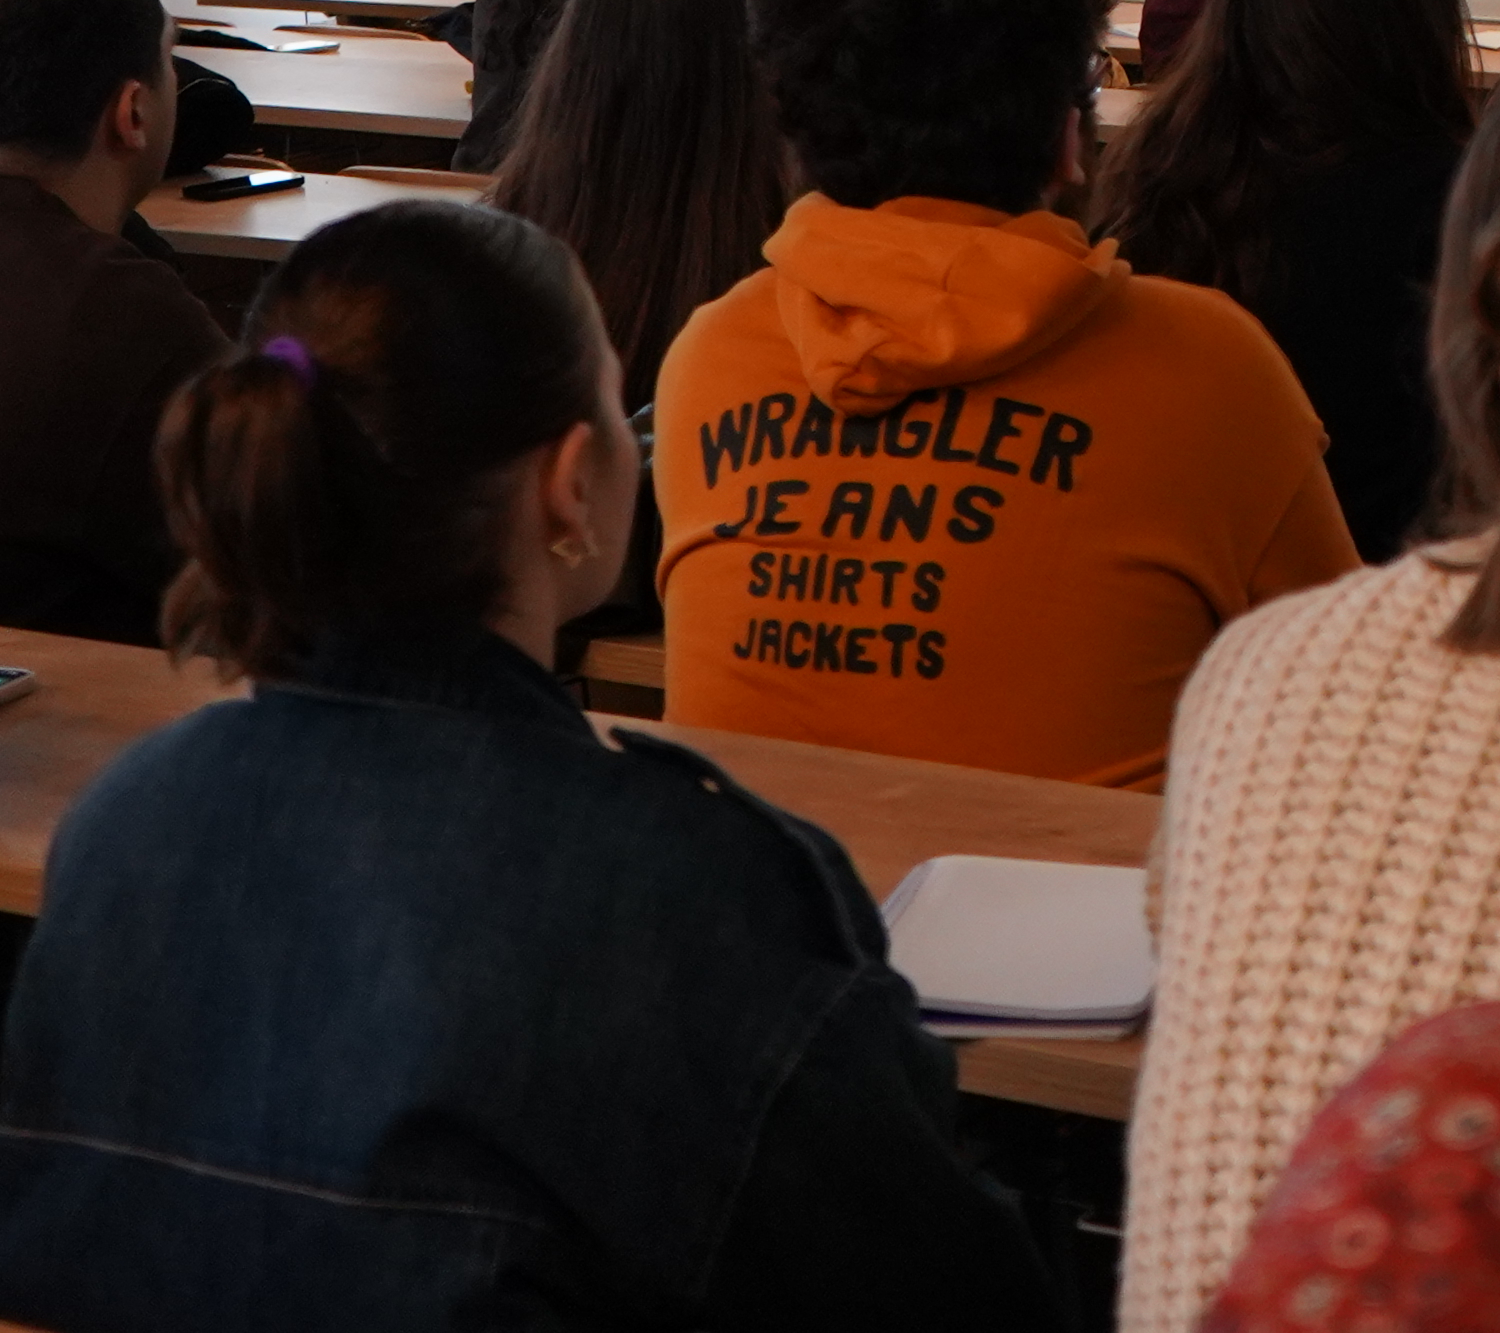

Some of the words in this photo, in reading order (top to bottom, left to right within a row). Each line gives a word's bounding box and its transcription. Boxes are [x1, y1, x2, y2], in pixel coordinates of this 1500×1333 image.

[712, 479, 1004, 544] JEANS
[748, 552, 946, 613] SHIRTS
[733, 619, 946, 680] JACKETS
